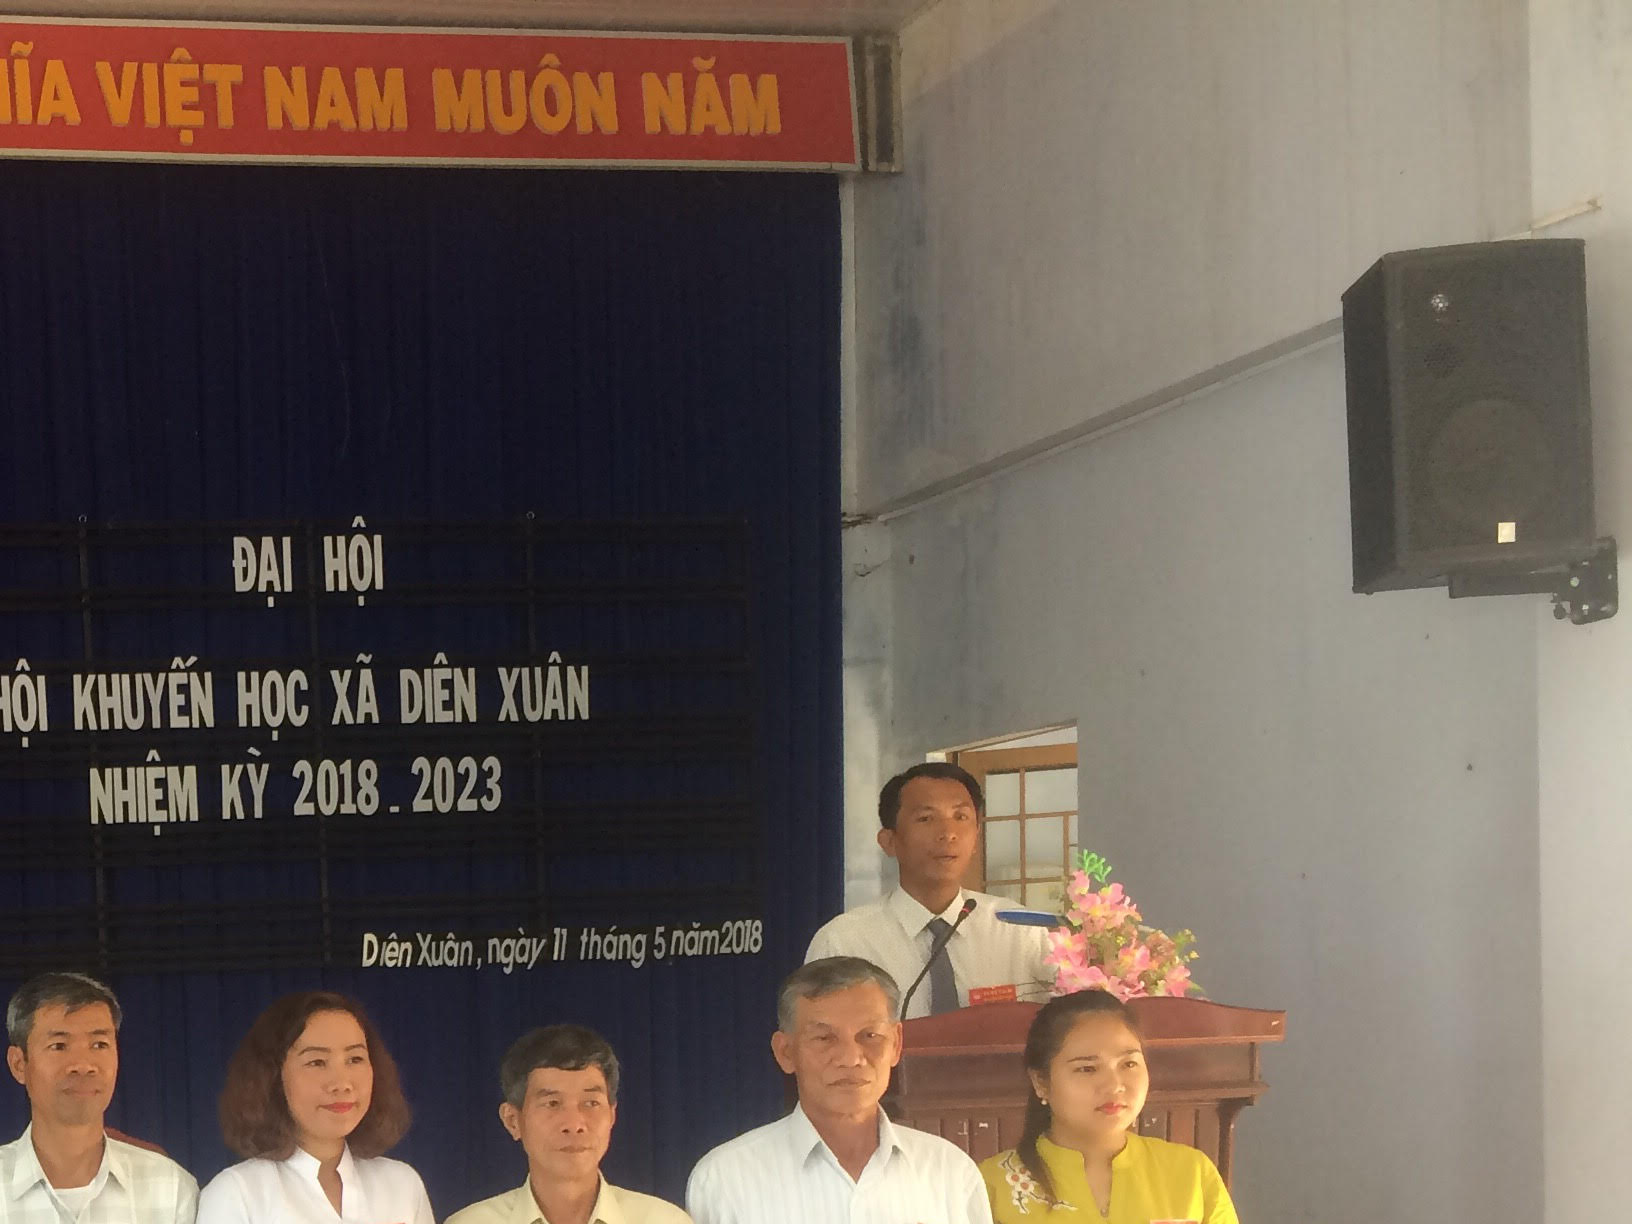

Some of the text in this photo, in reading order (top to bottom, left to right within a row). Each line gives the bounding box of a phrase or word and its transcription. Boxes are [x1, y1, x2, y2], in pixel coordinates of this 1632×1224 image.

[95, 47, 243, 146] VIỆT
[263, 65, 409, 131] NAM
[431, 51, 619, 134] MUÔN
[641, 56, 782, 136] NĂM
[232, 515, 384, 608] ĐẠI HỘI
[72, 655, 215, 731] KHUYẾN
[237, 669, 309, 741] HỌC
[329, 652, 380, 725] XÃ
[399, 652, 477, 724] DIÊN
[497, 651, 590, 722] XUÂN
[89, 749, 199, 836] NHIỆM
[220, 746, 270, 820] KỲ
[361, 932, 413, 968] Diên
[487, 927, 547, 975] ngày
[552, 927, 568, 961] 11
[579, 925, 647, 969] tháng
[653, 926, 666, 960] 5
